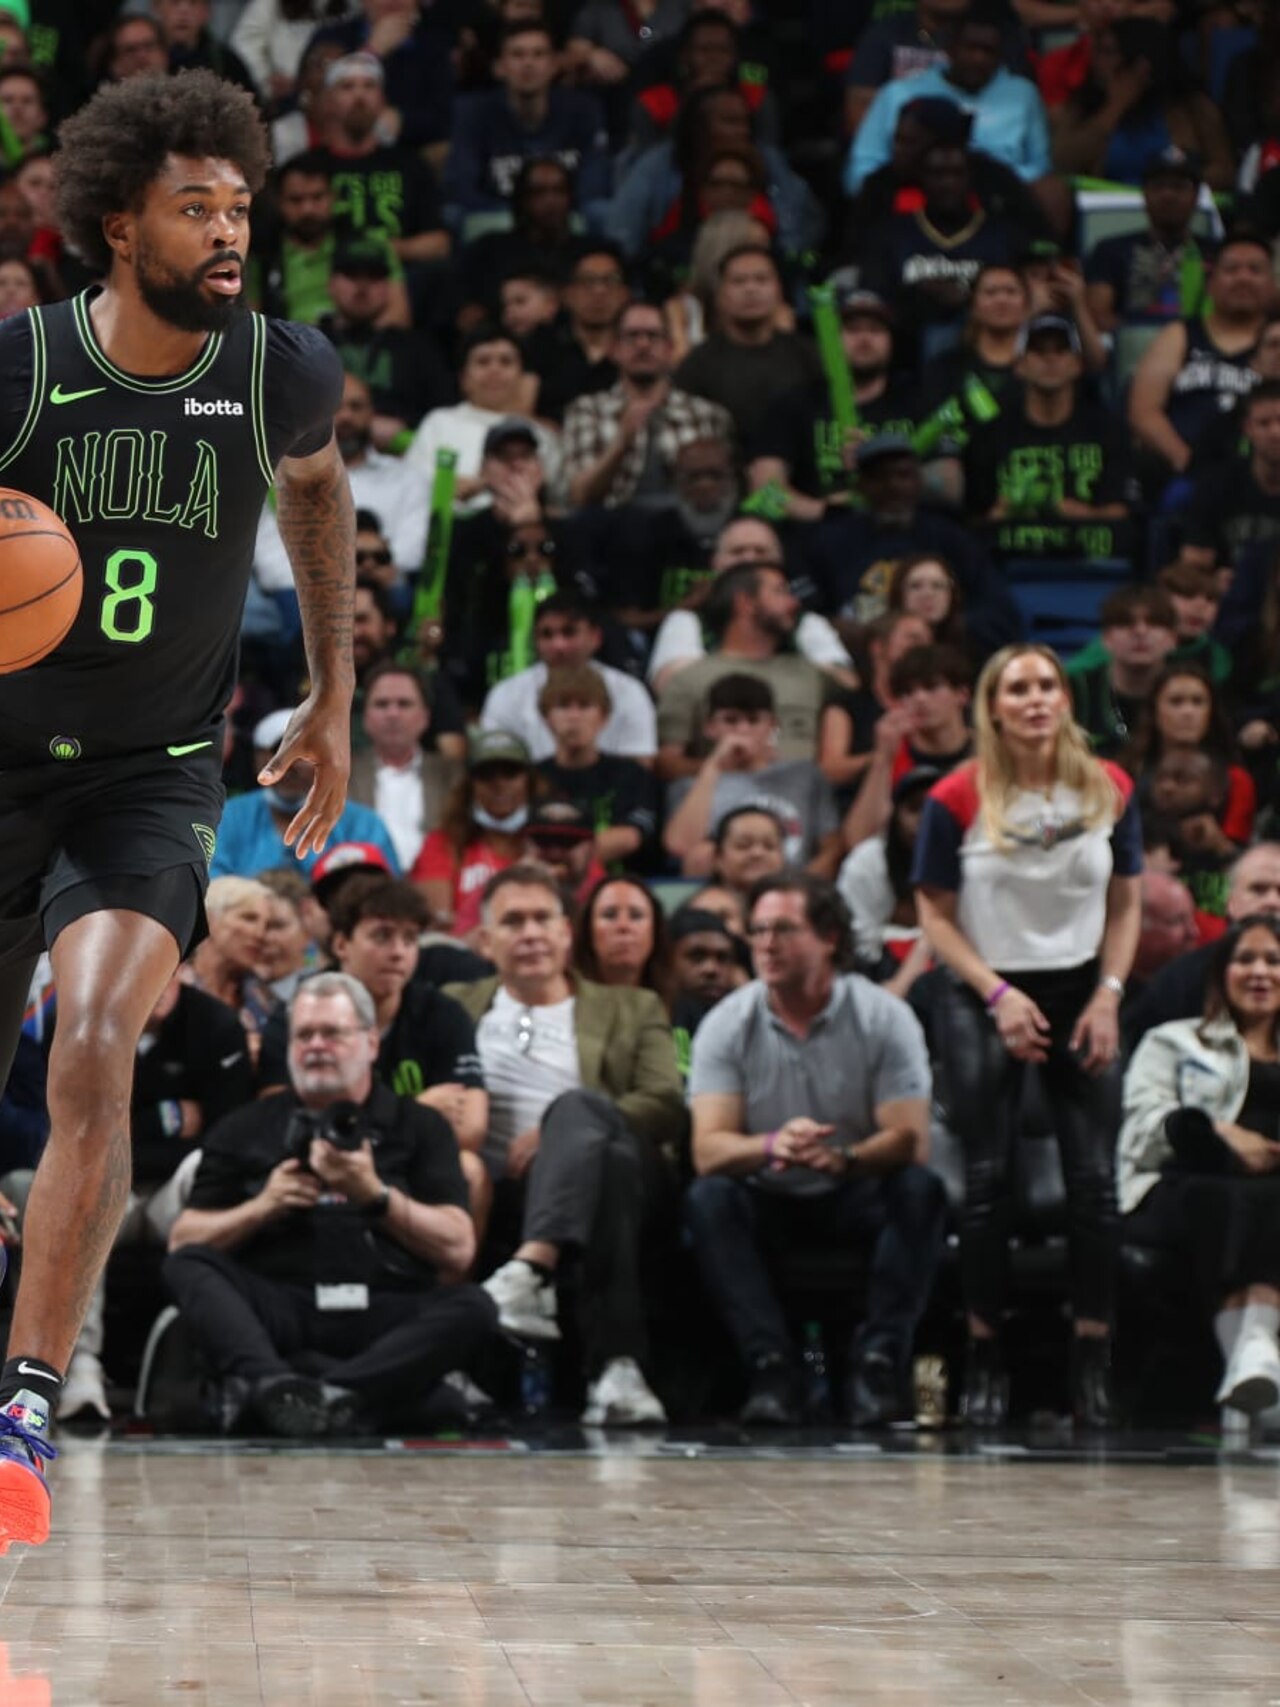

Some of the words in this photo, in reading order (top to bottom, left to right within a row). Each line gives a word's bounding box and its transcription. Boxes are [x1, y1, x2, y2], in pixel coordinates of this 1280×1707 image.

[184, 398, 245, 416] ibotta
[53, 428, 219, 539] NOLA
[99, 548, 159, 643] 8
